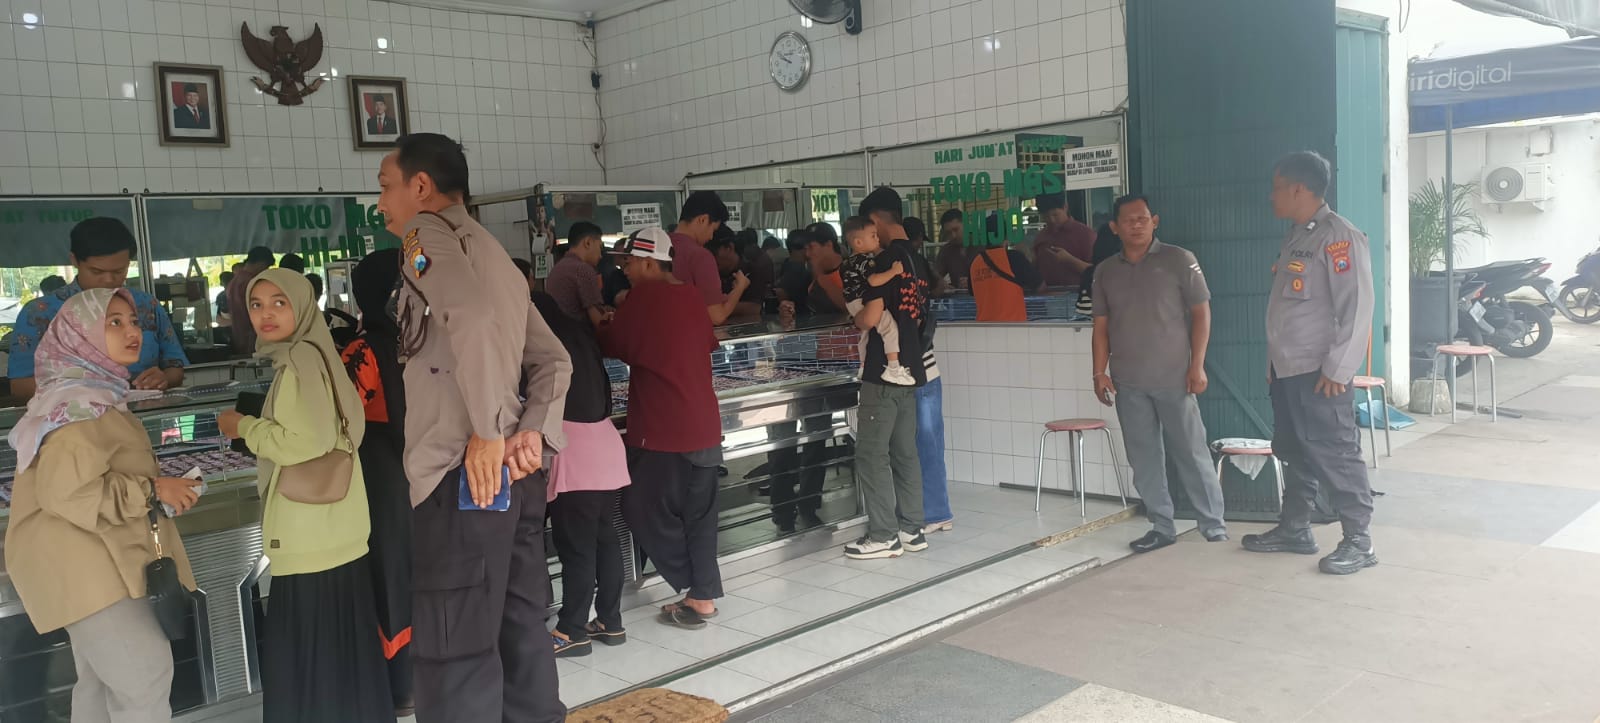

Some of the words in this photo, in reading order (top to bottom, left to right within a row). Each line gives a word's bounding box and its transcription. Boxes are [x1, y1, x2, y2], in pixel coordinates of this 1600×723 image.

[1408, 60, 1512, 92] iridigital
[934, 148, 963, 164] HARI
[968, 141, 1014, 160] JUM'AT
[1023, 135, 1066, 152] TUTUP
[1072, 151, 1094, 161] MOHON
[1095, 149, 1113, 159] MAAF
[929, 171, 991, 204] TOKO
[262, 203, 331, 231] TOKO
[962, 208, 1024, 247] HIJO
